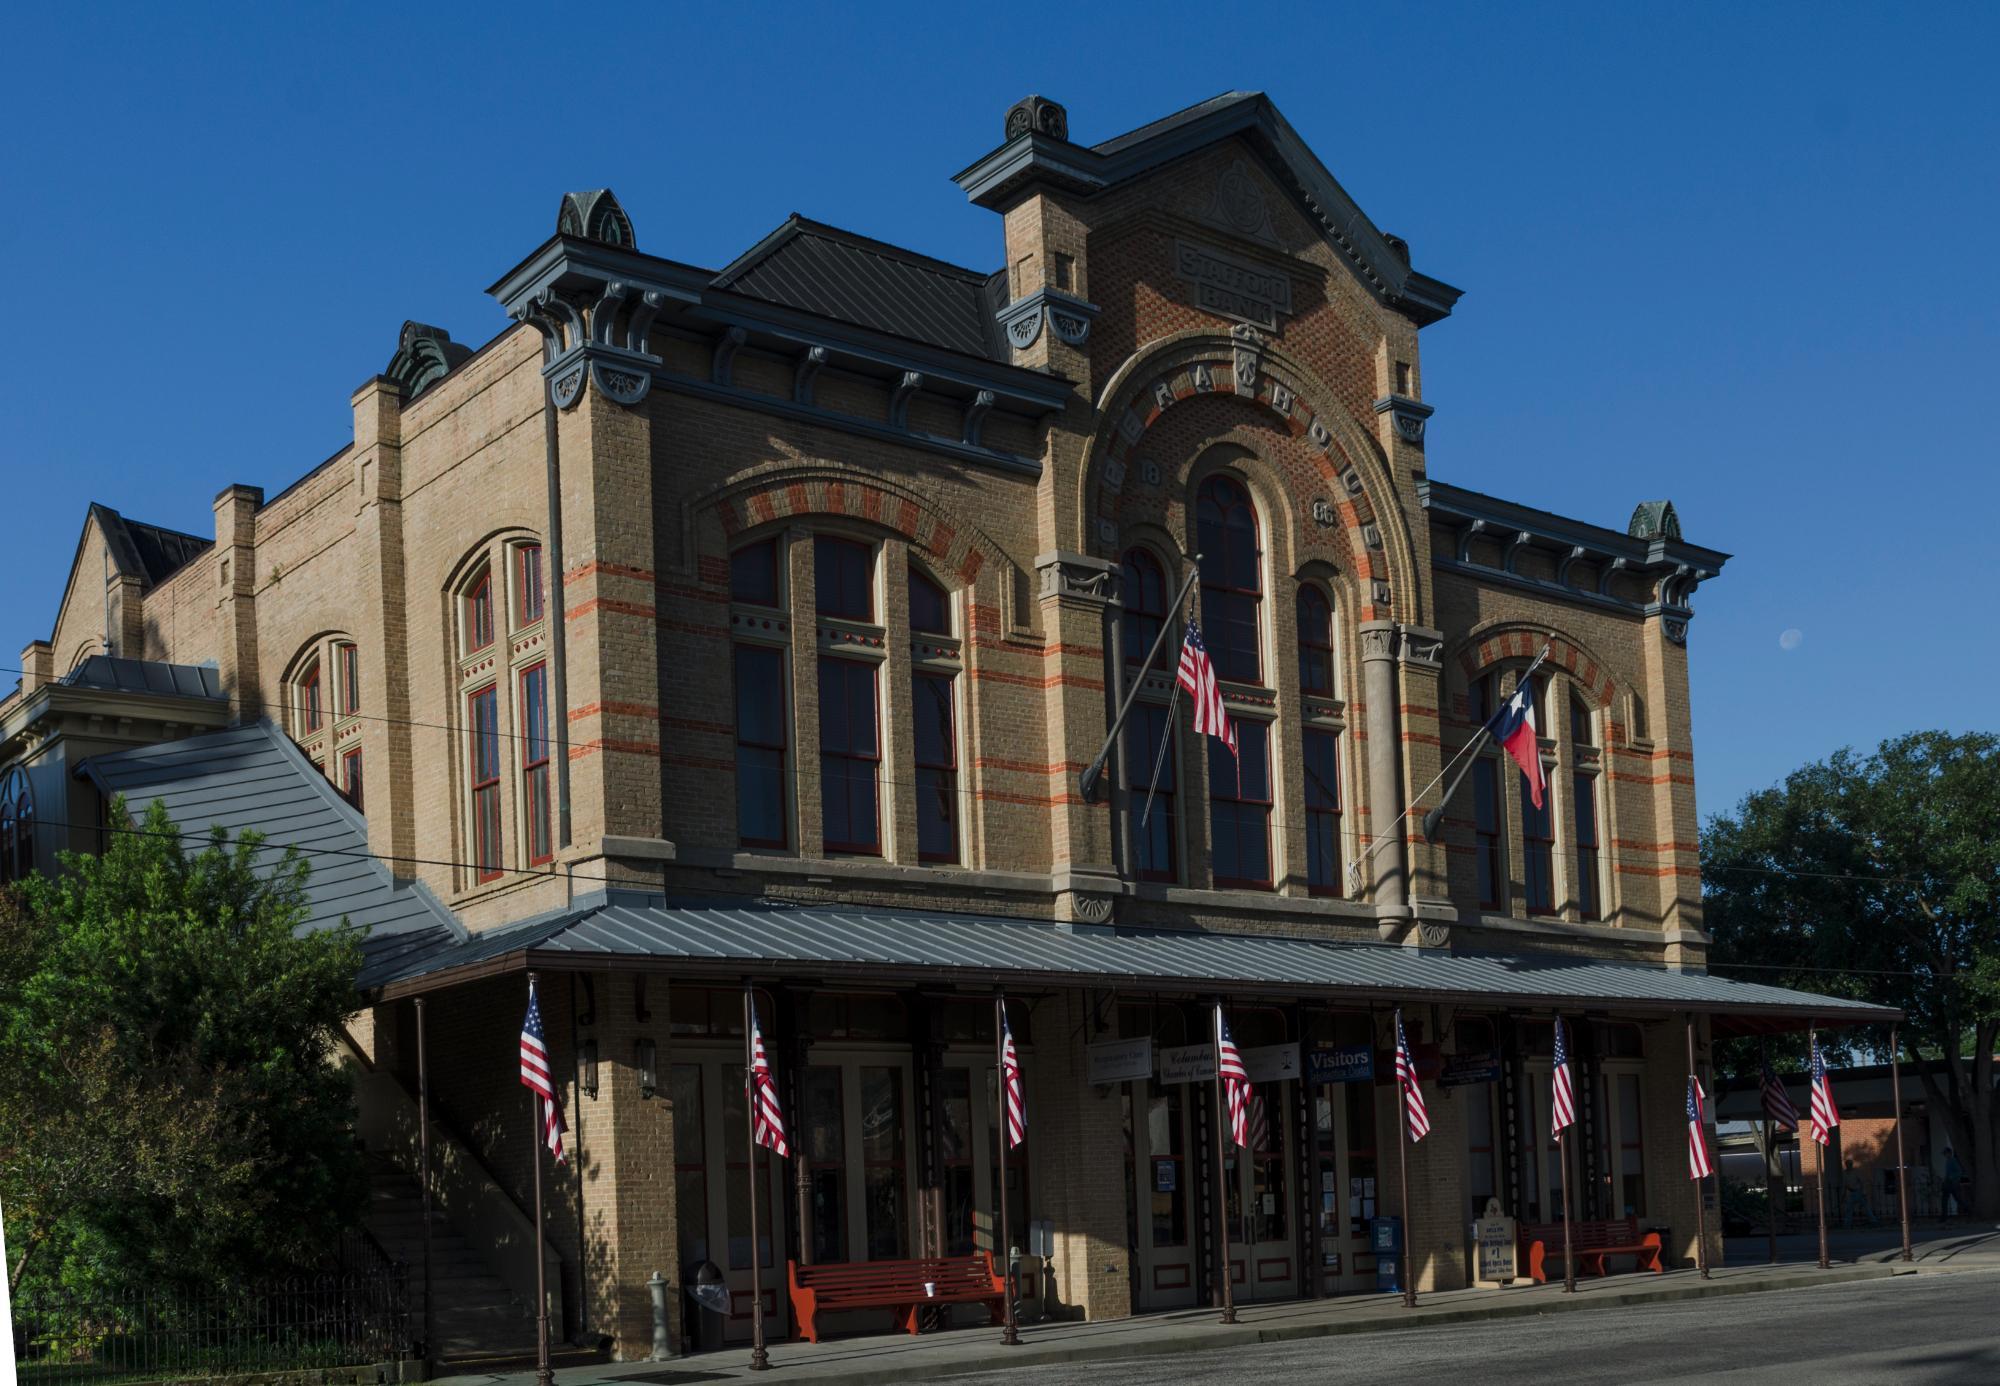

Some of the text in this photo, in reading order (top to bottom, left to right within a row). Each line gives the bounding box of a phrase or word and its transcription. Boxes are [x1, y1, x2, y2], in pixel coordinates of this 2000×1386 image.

[1204, 287, 1272, 326] BANK
[1099, 364, 1391, 605] OPERA HOUSE
[1140, 460, 1335, 526] 18 86
[1310, 1051, 1369, 1069] Visitors
